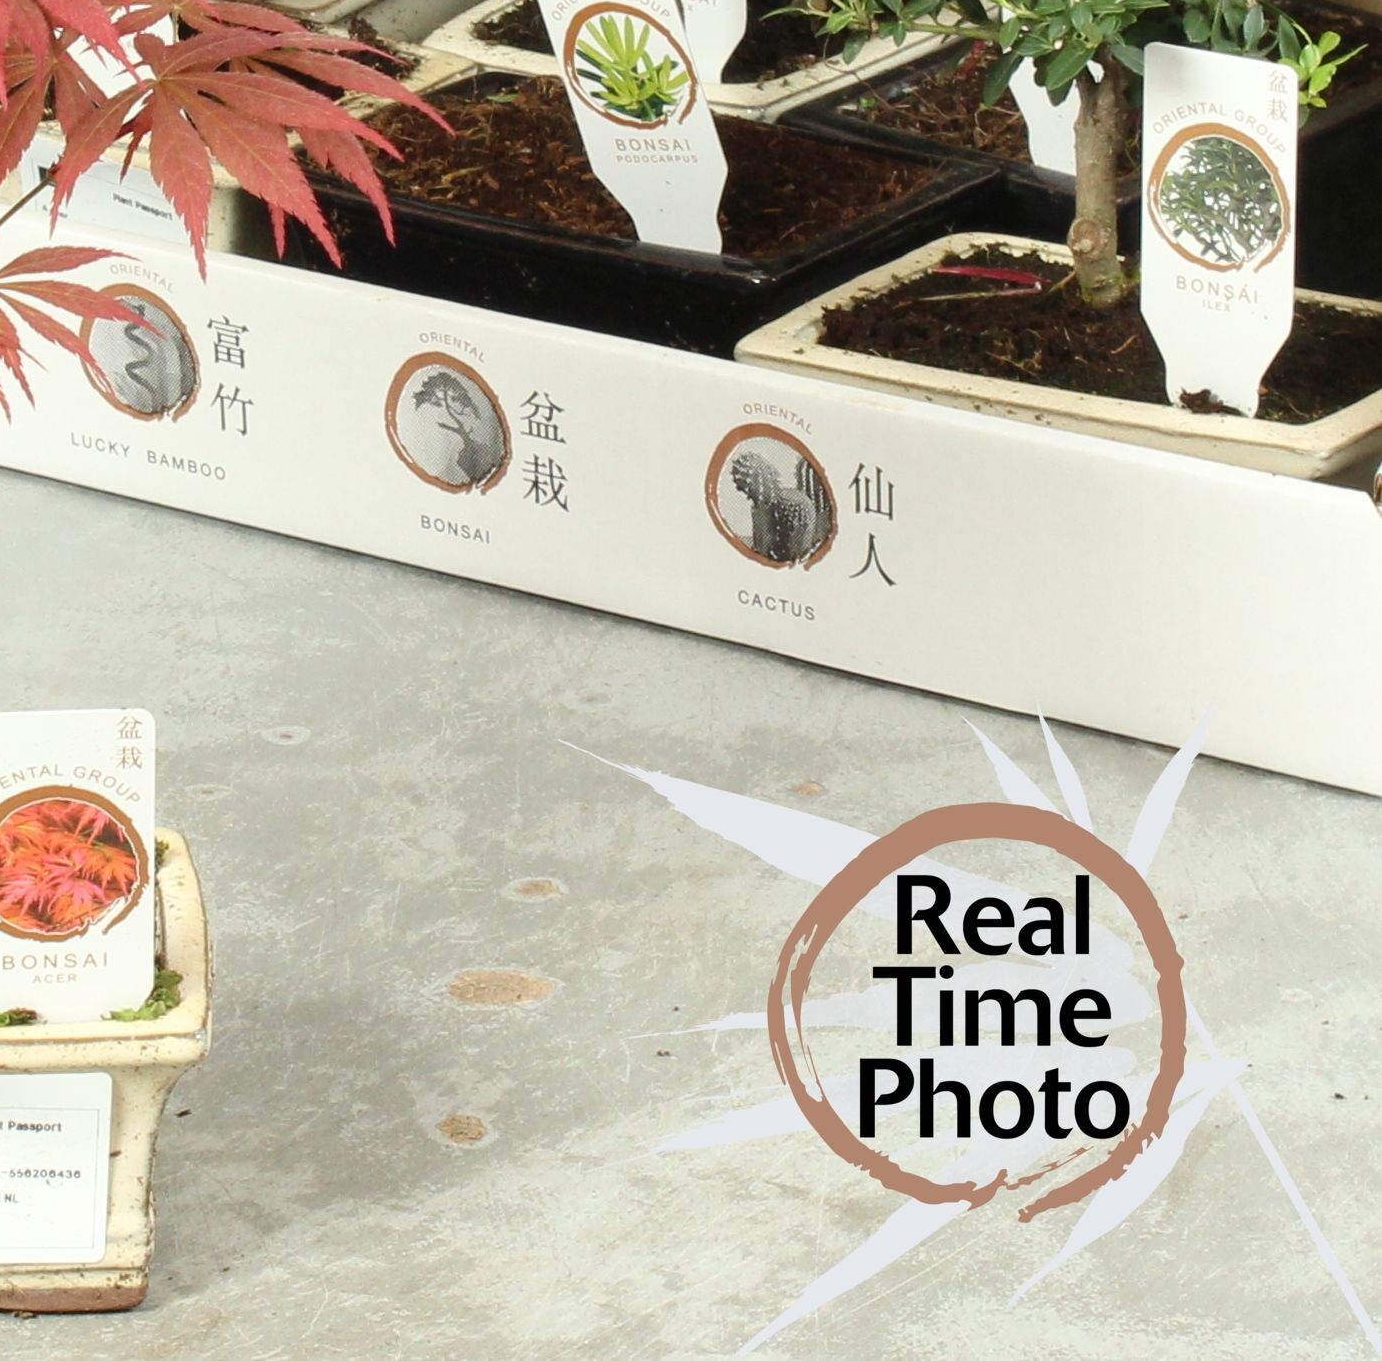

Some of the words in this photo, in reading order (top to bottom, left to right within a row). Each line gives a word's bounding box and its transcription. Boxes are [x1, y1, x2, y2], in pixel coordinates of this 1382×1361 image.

[1153, 101, 1227, 135] ORIENTAL
[1234, 109, 1287, 155] GROUP
[615, 138, 691, 151] BONSAI
[616, 155, 698, 163] PODOCARPUS
[109, 264, 174, 293] ORIENTAL
[1177, 276, 1259, 304] BONSAI
[1202, 299, 1231, 312] ILEX
[419, 332, 486, 363] ORIENTAL
[206, 315, 254, 436] 富竹
[742, 403, 812, 435] ORIENTAL
[71, 432, 130, 458] LUCKY
[147, 450, 226, 481] BAMBOO
[520, 390, 570, 513] 盆栽
[420, 515, 491, 544] BONSAI
[849, 462, 897, 587] 仙人
[738, 590, 816, 621] CACTUS
[117, 716, 143, 770] 盆栽
[73, 765, 141, 806] GROUP
[2, 953, 108, 970] BONSAI
[33, 973, 79, 984] ACER
[8, 1121, 62, 1133] Passport
[4, 1193, 19, 1204] NL
